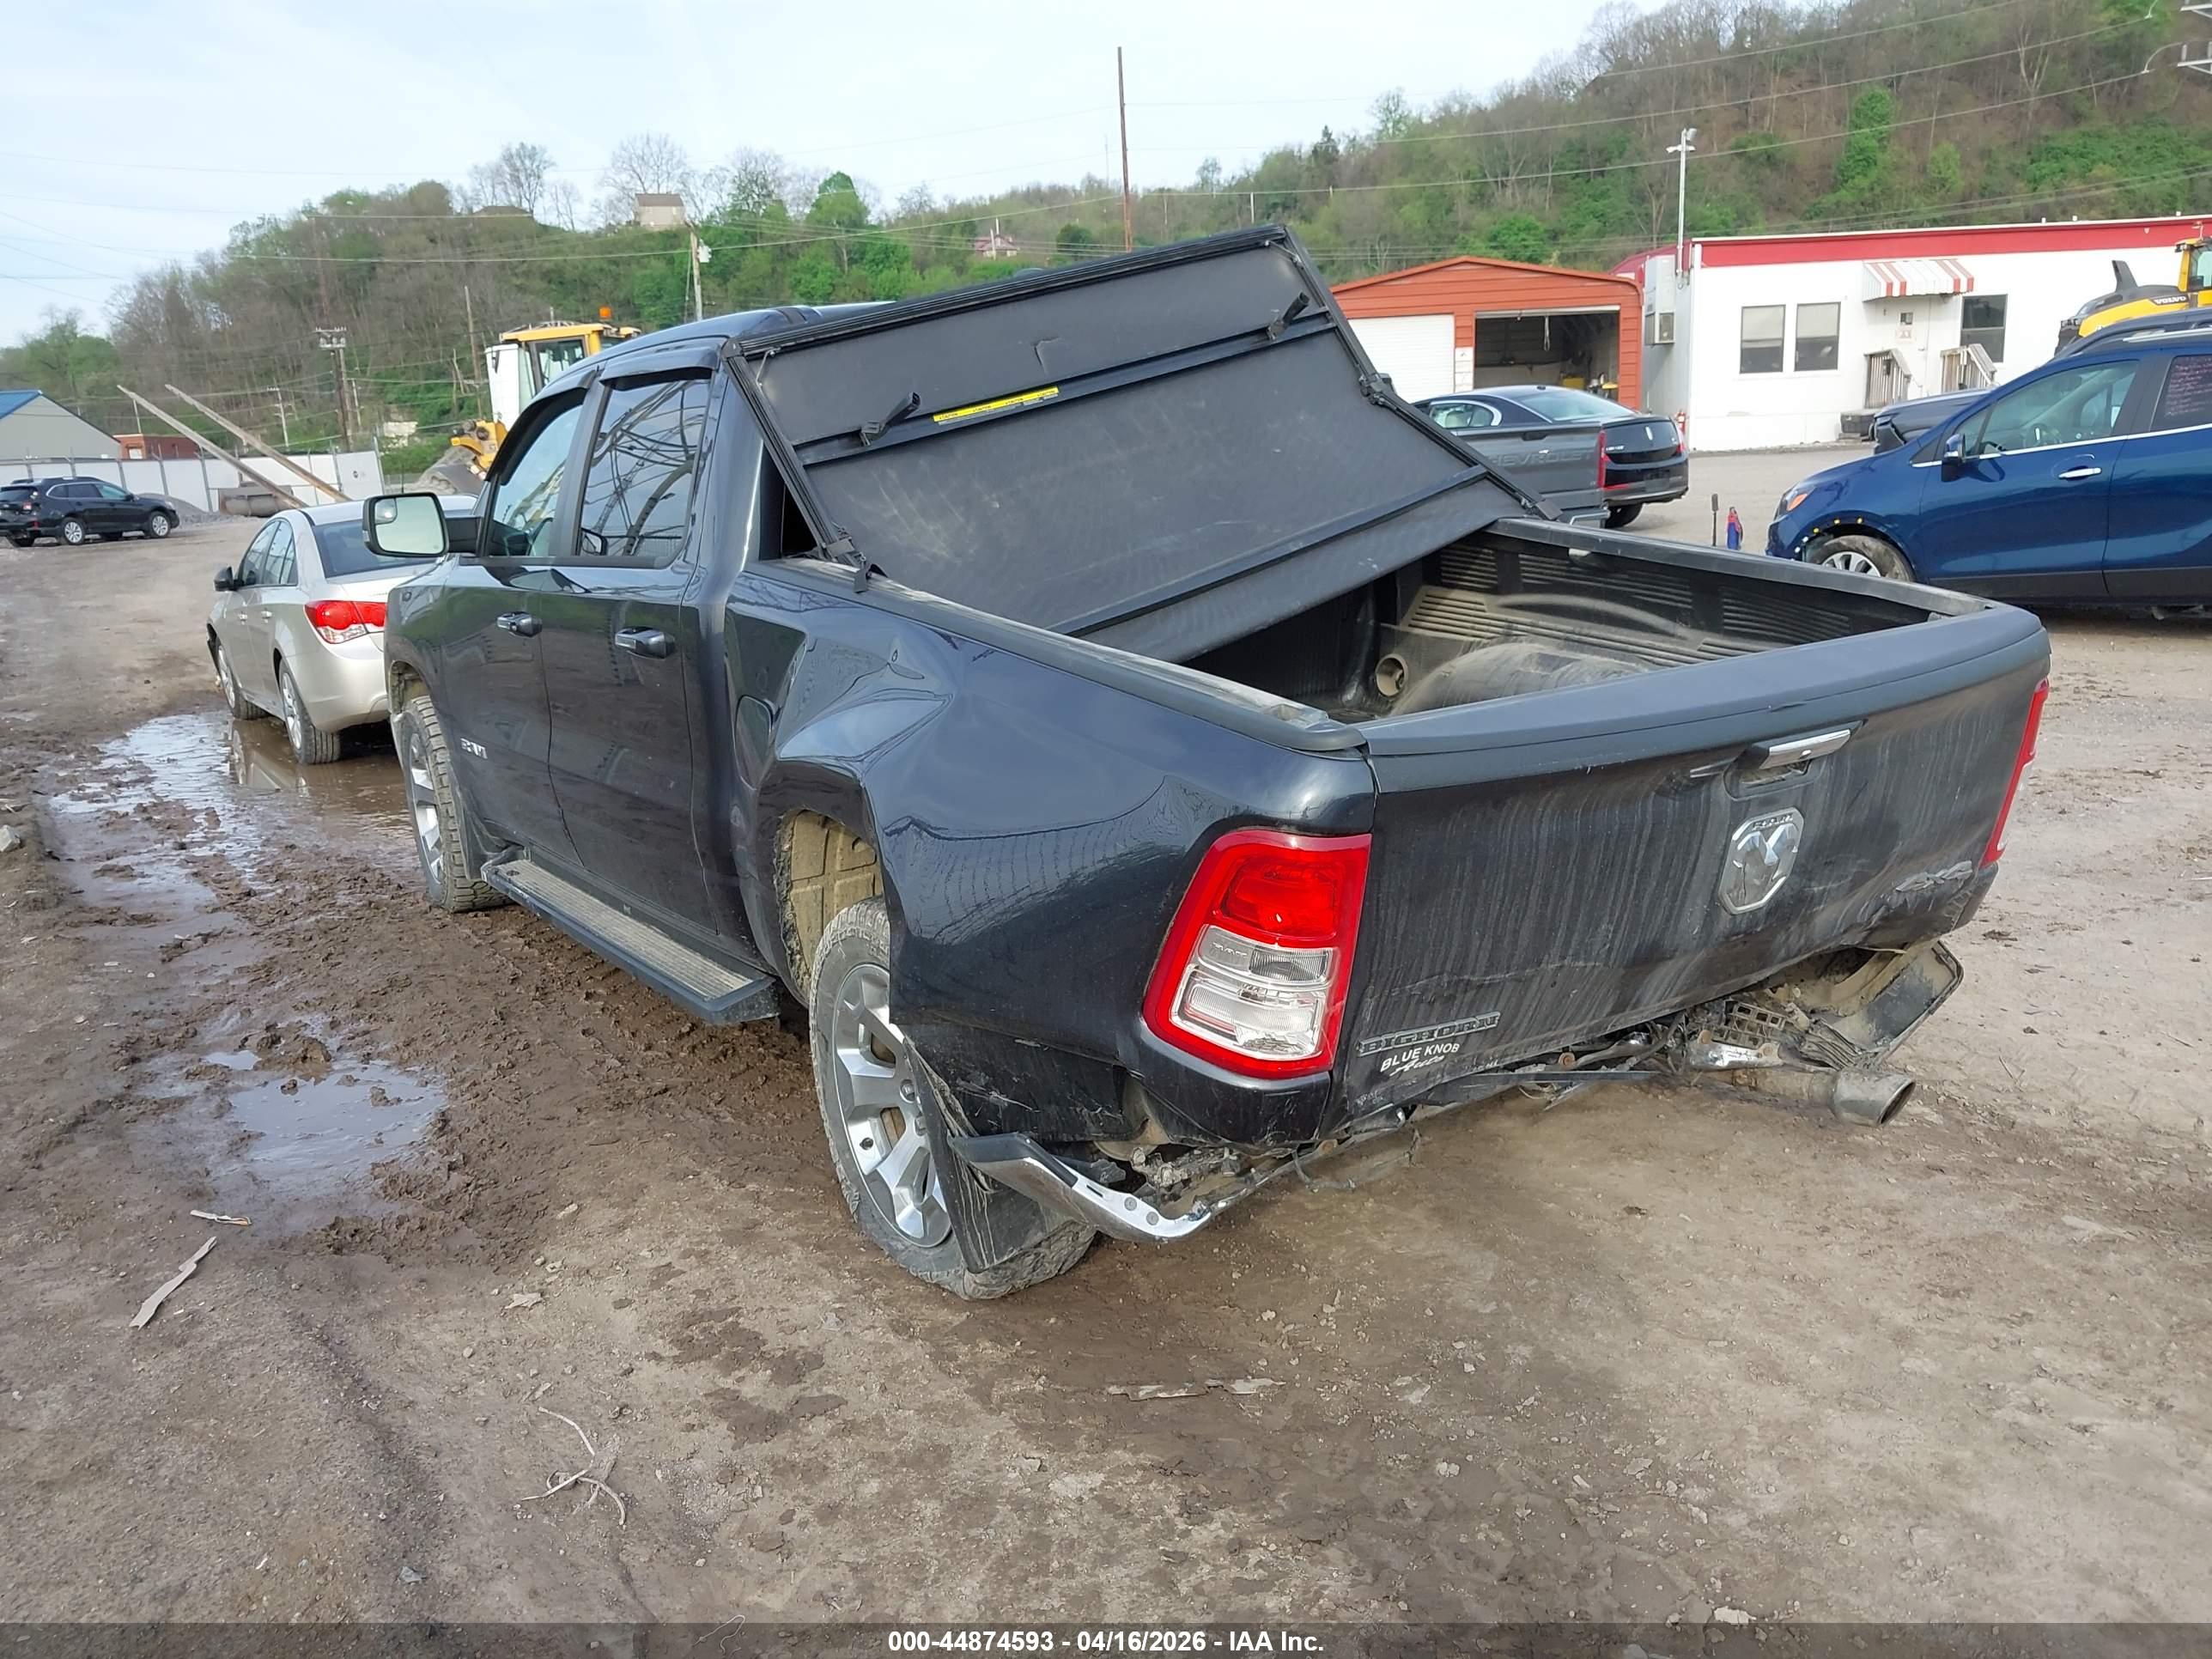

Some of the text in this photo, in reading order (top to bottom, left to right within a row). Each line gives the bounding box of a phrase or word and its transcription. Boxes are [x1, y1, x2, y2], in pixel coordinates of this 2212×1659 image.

[2154, 295, 2187, 305] VOLVO
[1486, 448, 1595, 467] HEVROLET
[1751, 811, 1795, 832] RAM
[1380, 1042, 1461, 1073] BLUE KNOB
[1389, 1054, 1445, 1077] Auto
